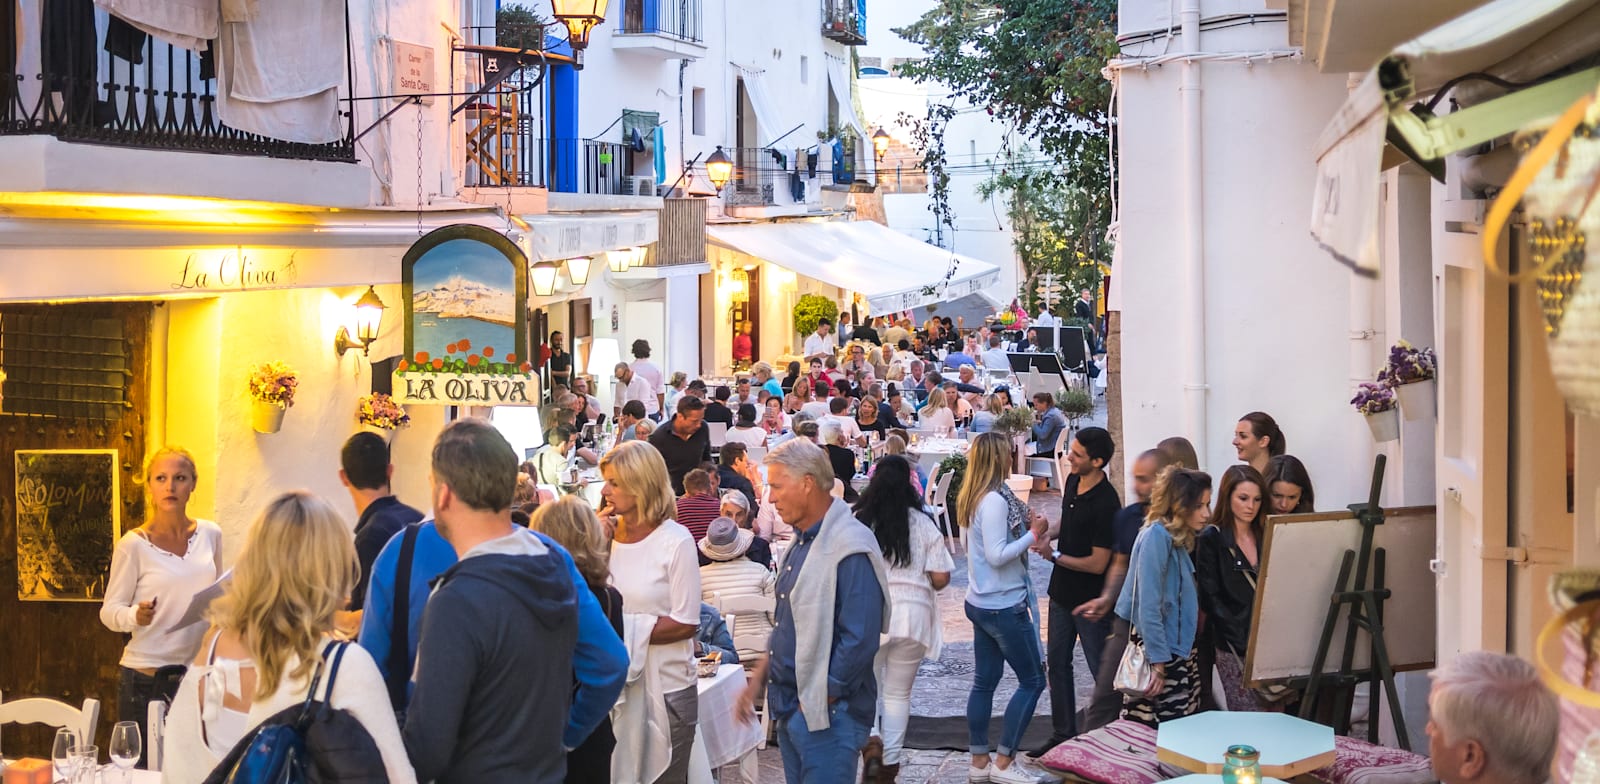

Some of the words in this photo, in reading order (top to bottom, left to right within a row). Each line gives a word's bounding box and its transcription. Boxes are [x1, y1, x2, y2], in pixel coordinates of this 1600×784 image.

[400, 76, 416, 90] Santa
[416, 79, 430, 92] Creu
[171, 253, 209, 289] La
[219, 251, 278, 286] Oliva
[405, 379, 440, 400] LA
[445, 379, 530, 403] OLIVA
